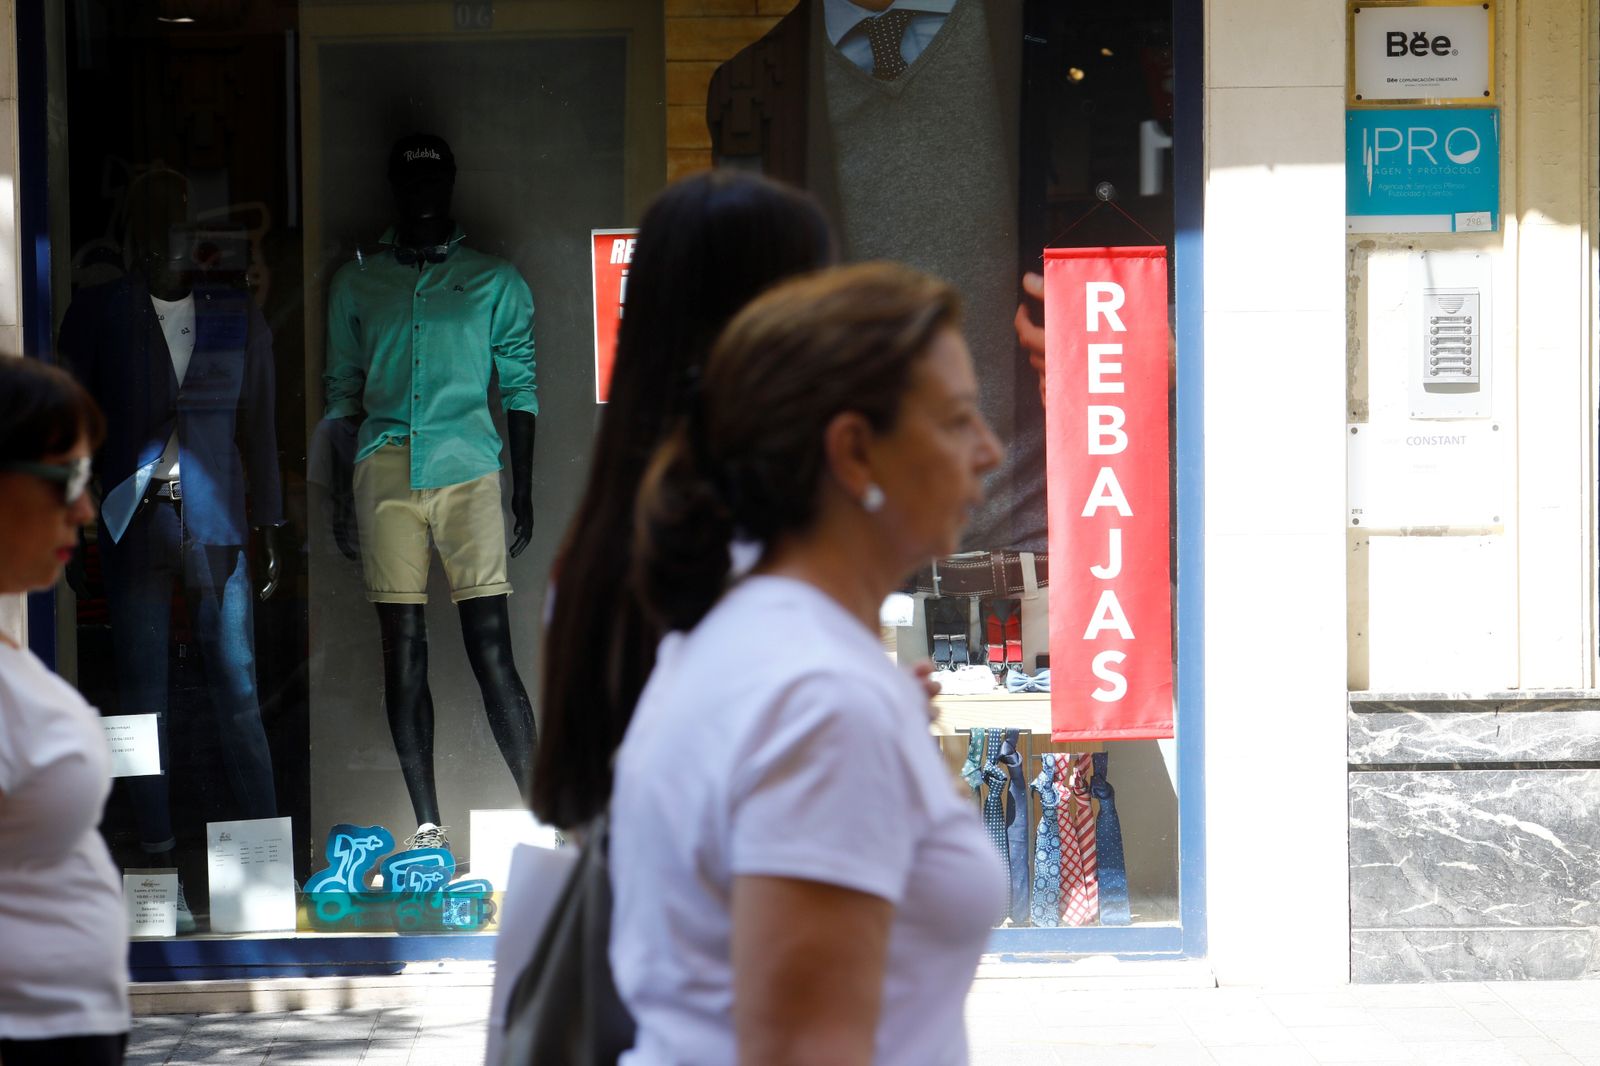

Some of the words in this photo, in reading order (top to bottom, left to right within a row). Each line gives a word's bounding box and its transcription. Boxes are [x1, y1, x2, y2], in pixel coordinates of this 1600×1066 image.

[1362, 127, 1481, 166] IPRO
[1362, 167, 1402, 176] IAGEN
[1406, 167, 1413, 175] Y
[1406, 435, 1467, 446] CONSTANT
[1081, 281, 1134, 702] REBAJAS
